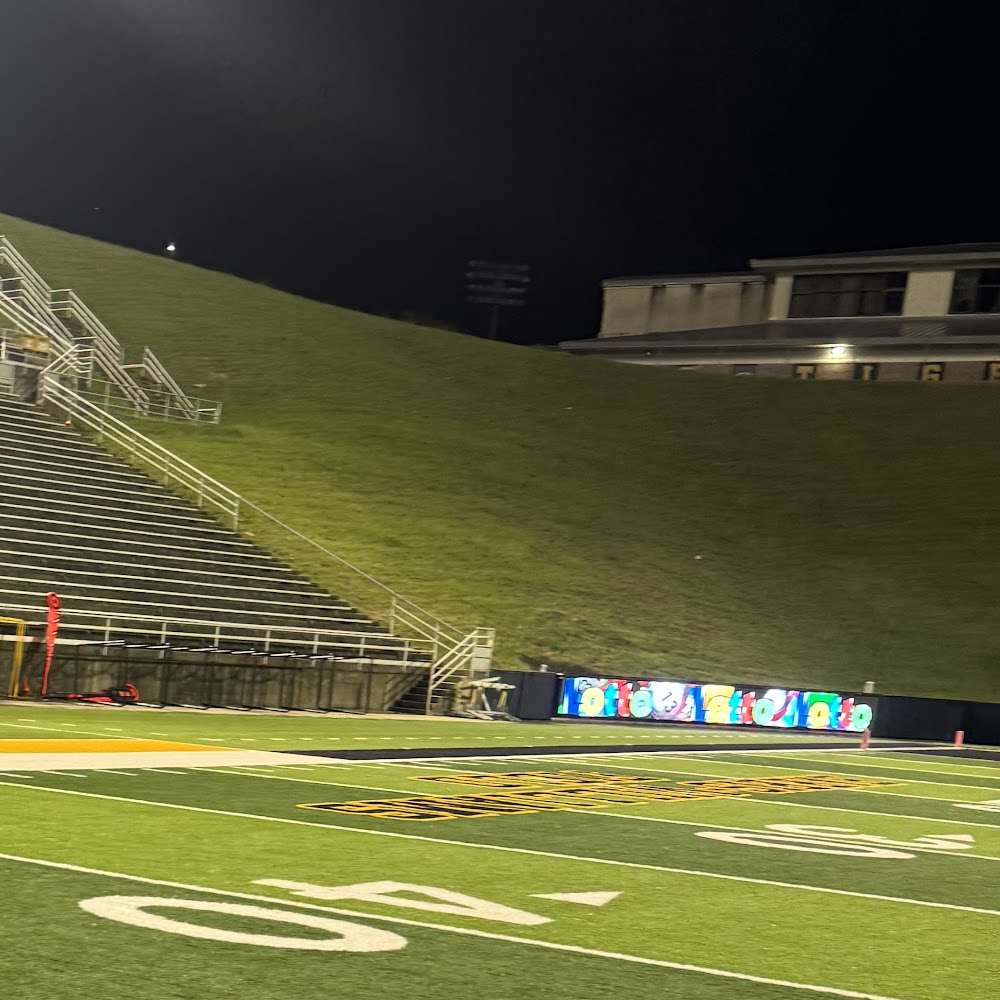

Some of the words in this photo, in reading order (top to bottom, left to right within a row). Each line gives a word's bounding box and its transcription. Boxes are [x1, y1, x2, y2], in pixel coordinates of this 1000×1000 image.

[564, 678, 653, 718] Lotto
[797, 692, 873, 732] Lotto
[694, 823, 974, 859] 30
[77, 878, 557, 952] 40
